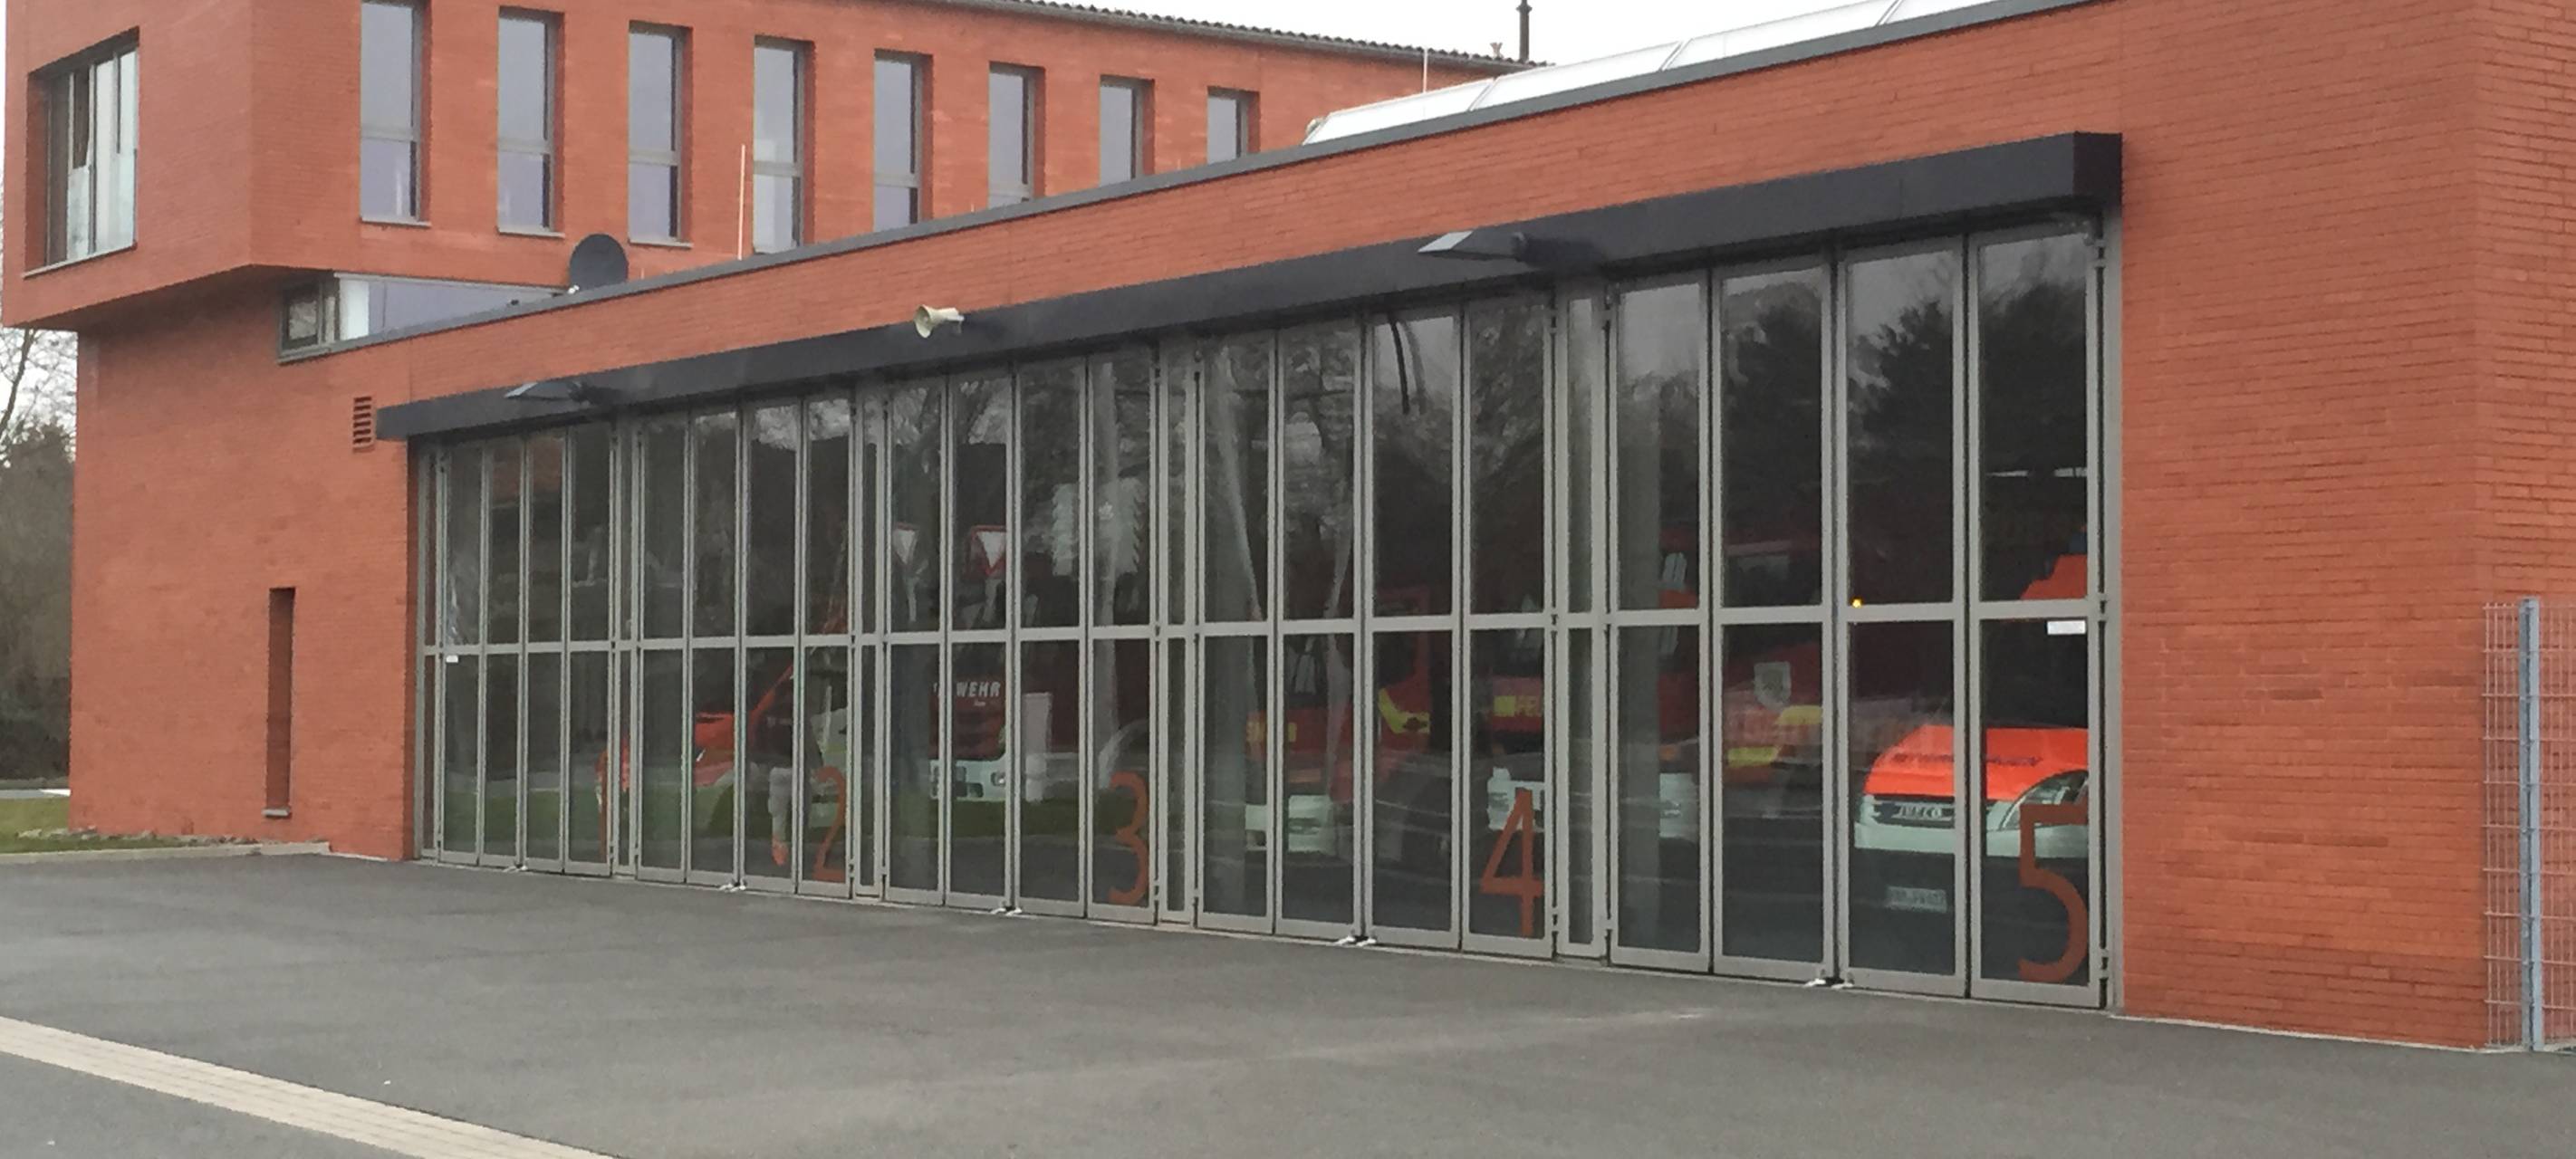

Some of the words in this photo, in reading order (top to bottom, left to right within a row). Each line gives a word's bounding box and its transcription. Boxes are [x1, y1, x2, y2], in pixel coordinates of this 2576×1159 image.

[812, 765, 847, 883] 2
[1108, 771, 1149, 906] 3
[1479, 787, 1545, 938] 4
[2018, 802, 2089, 983] 5
